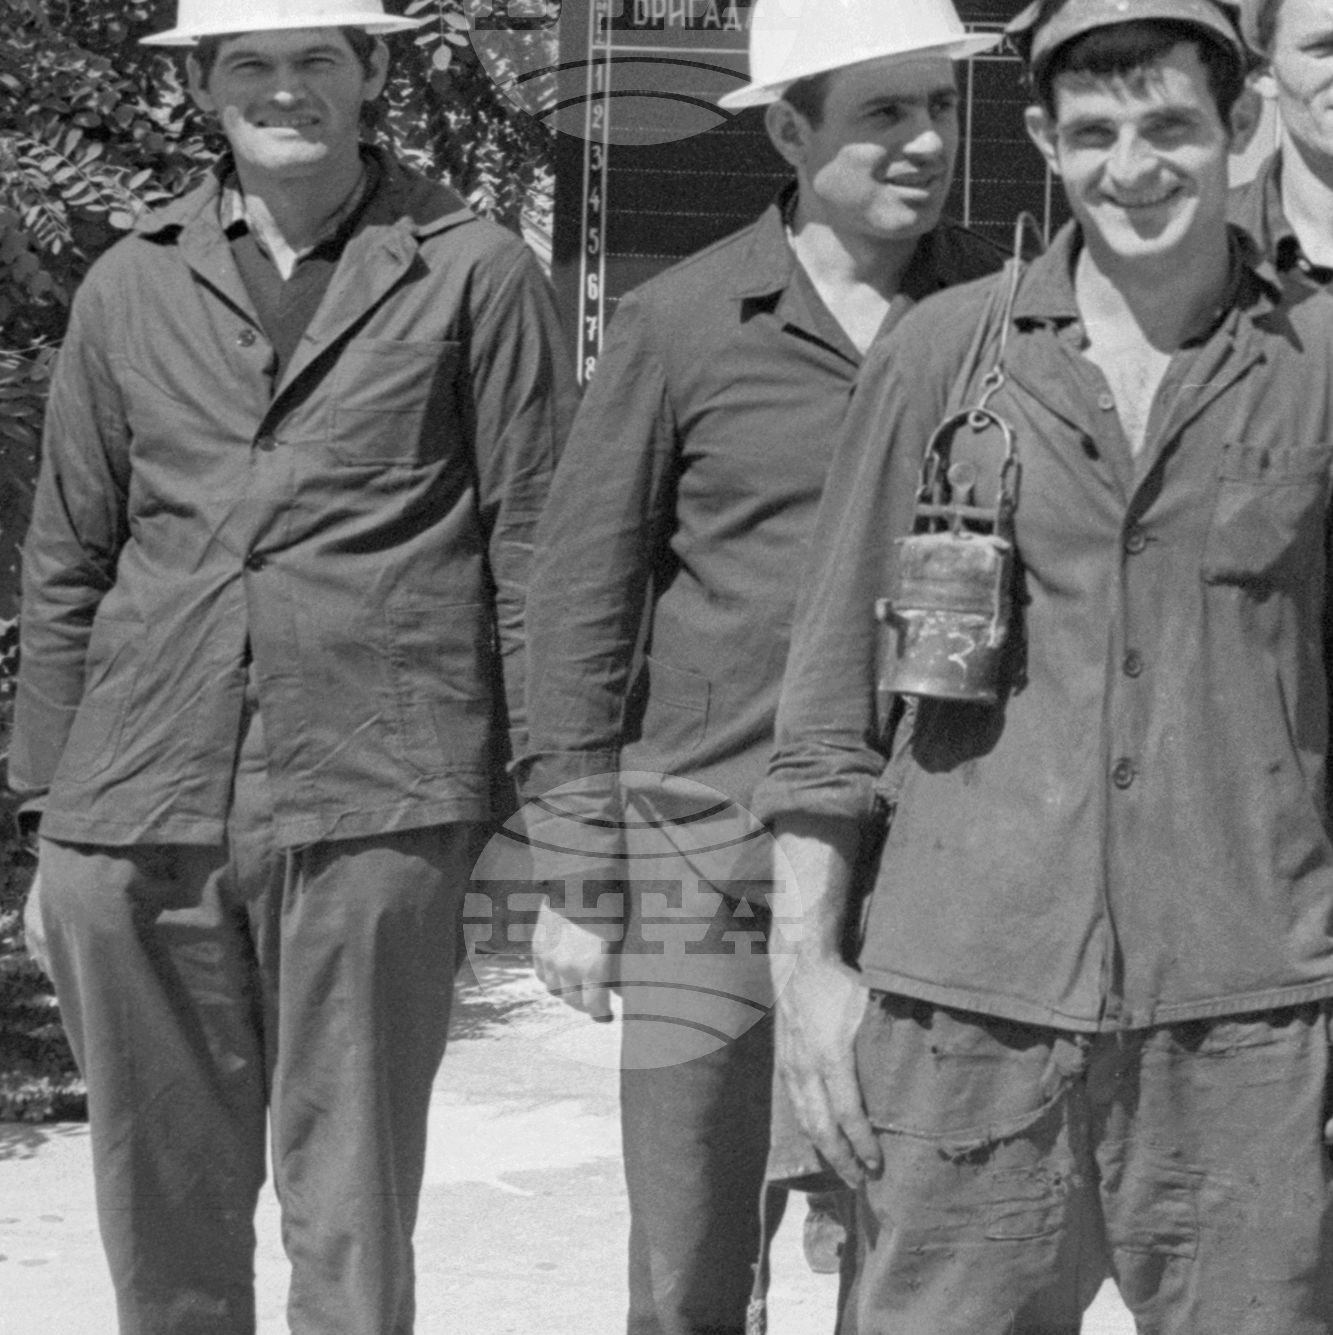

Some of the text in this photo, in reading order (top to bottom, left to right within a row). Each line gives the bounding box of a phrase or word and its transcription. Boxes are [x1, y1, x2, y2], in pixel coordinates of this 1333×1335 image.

[590, 144, 603, 170] 3
[588, 186, 600, 212] 4
[588, 227, 600, 254] 5
[586, 272, 599, 300] 6
[585, 315, 598, 342] 7
